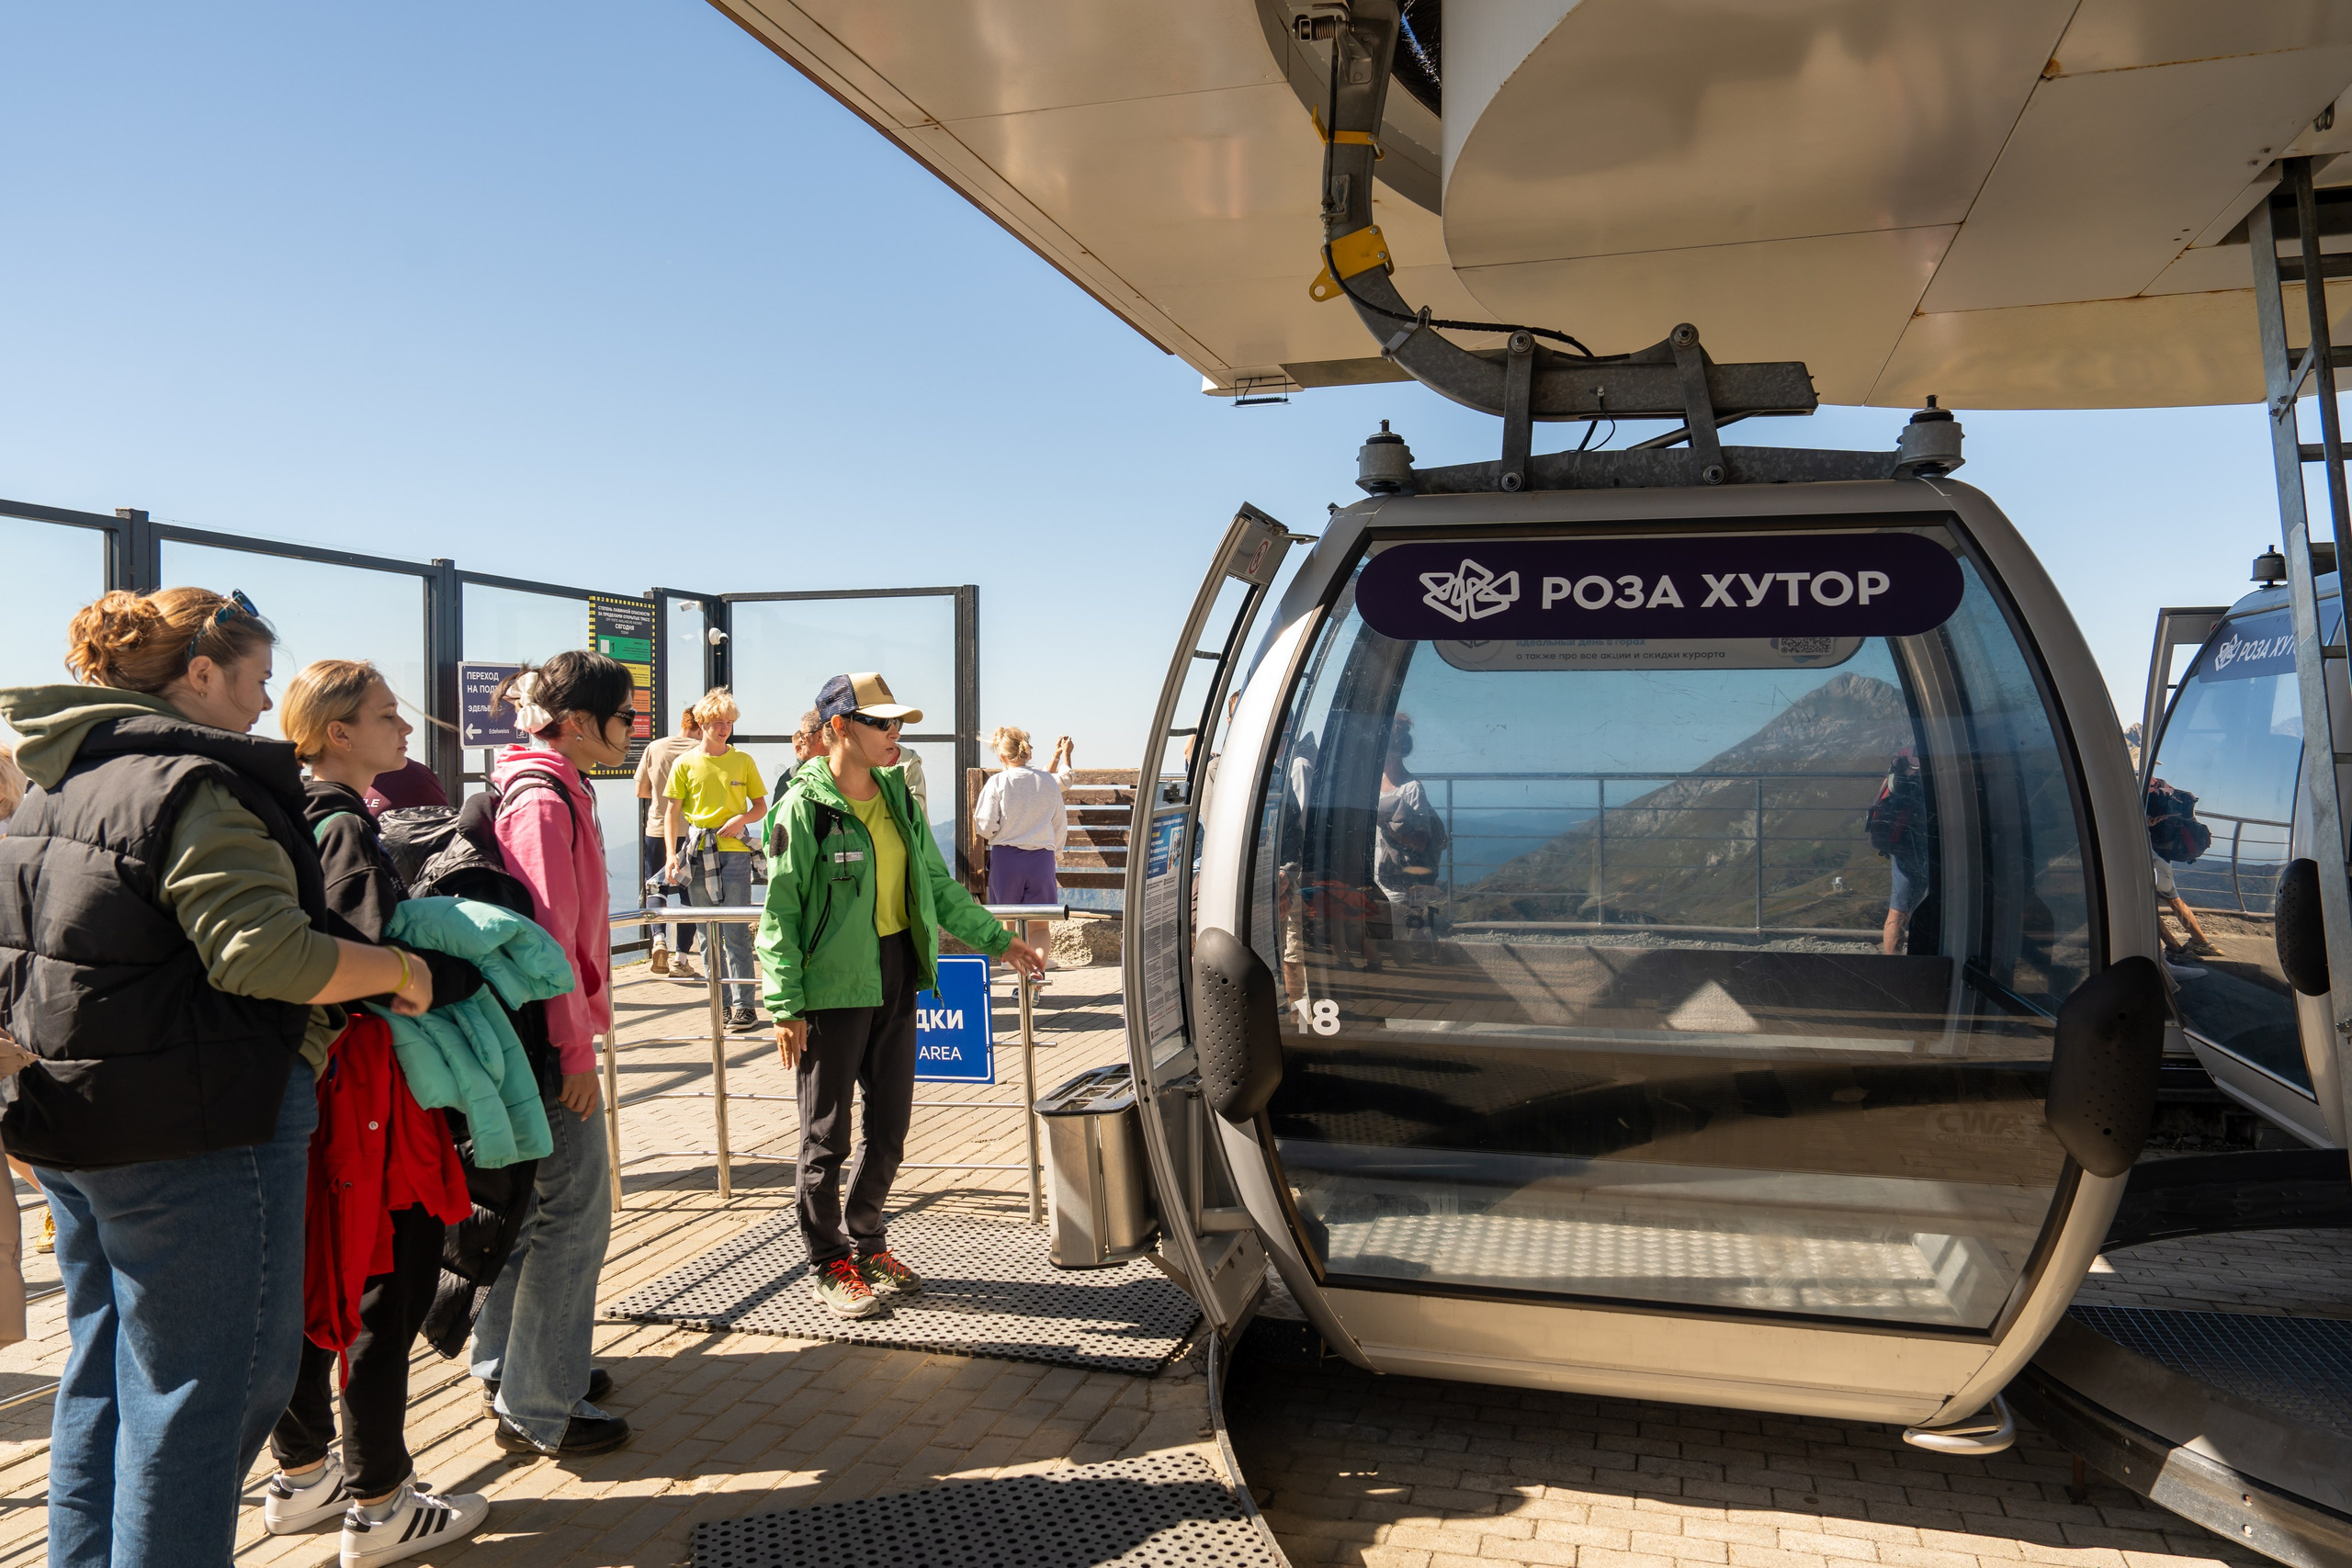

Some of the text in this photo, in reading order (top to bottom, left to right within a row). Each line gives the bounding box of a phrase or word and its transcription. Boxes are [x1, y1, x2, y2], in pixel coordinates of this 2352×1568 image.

[1541, 570, 1891, 611] РОЗА ХУТОР
[611, 642, 615, 652] 1
[1558, 653, 1577, 661] про
[1600, 652, 1632, 660] акции
[1682, 651, 1725, 660] курорта
[2236, 637, 2272, 662] РОЗА
[467, 671, 500, 682] ПЕРЕХОД
[467, 684, 497, 694] НА ПОД
[916, 1009, 964, 1032] ДКИ
[1291, 998, 1340, 1036] 18
[919, 1045, 963, 1061] AREA
[1936, 1111, 2024, 1134] CWA
